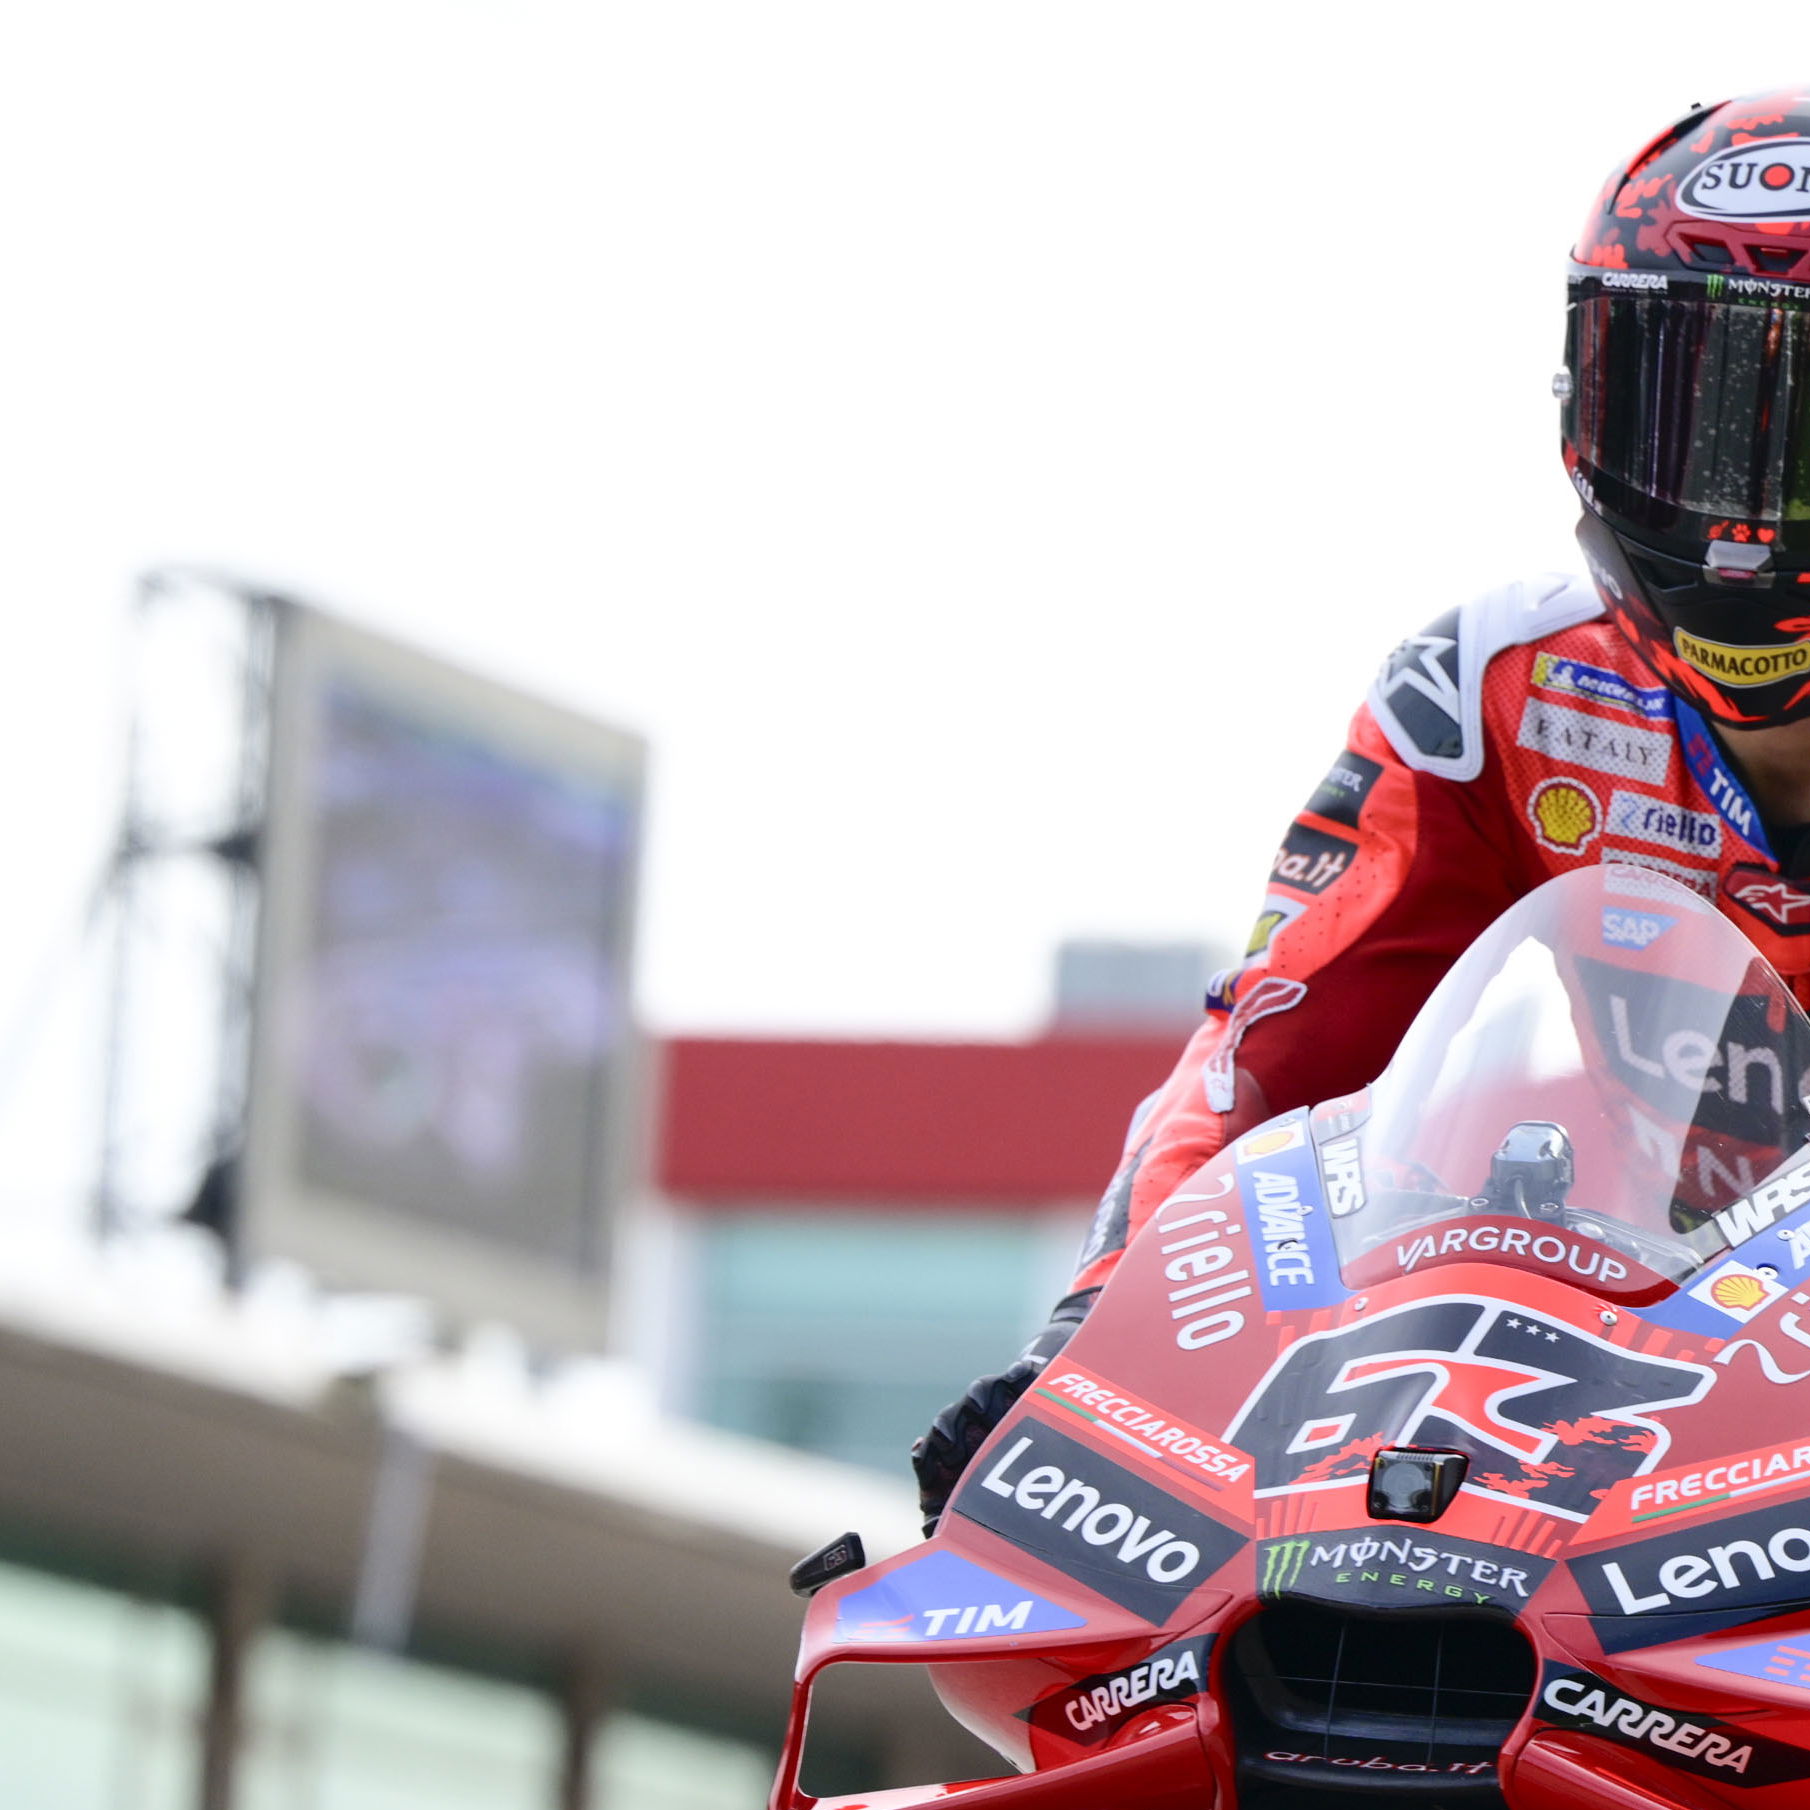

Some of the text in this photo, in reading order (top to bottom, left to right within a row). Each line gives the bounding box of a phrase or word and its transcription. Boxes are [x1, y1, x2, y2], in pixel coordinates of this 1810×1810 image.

[1601, 272, 1668, 291] CARRERA
[1681, 640, 1808, 677] PARMACOTTO
[1643, 806, 1717, 846] riello
[1710, 769, 1753, 837] TIM
[1603, 913, 1661, 947] SAP
[1321, 1139, 1366, 1216] WRS
[1252, 1170, 1315, 1287] ADVANCE
[1397, 1225, 1628, 1283] VARGROUP
[1158, 1210, 1254, 1351] riello
[1048, 1372, 1253, 1484] FRECCIAROSSA
[1220, 1292, 1718, 1525] 63
[980, 1436, 1200, 1584] Lenovo
[1310, 1536, 1530, 1598] MONSTER
[1335, 1570, 1491, 1605] ENERGY
[922, 1600, 1034, 1637] TIM
[1064, 1650, 1200, 1732] CARRERA
[1542, 1678, 1754, 1775] CARRERA
